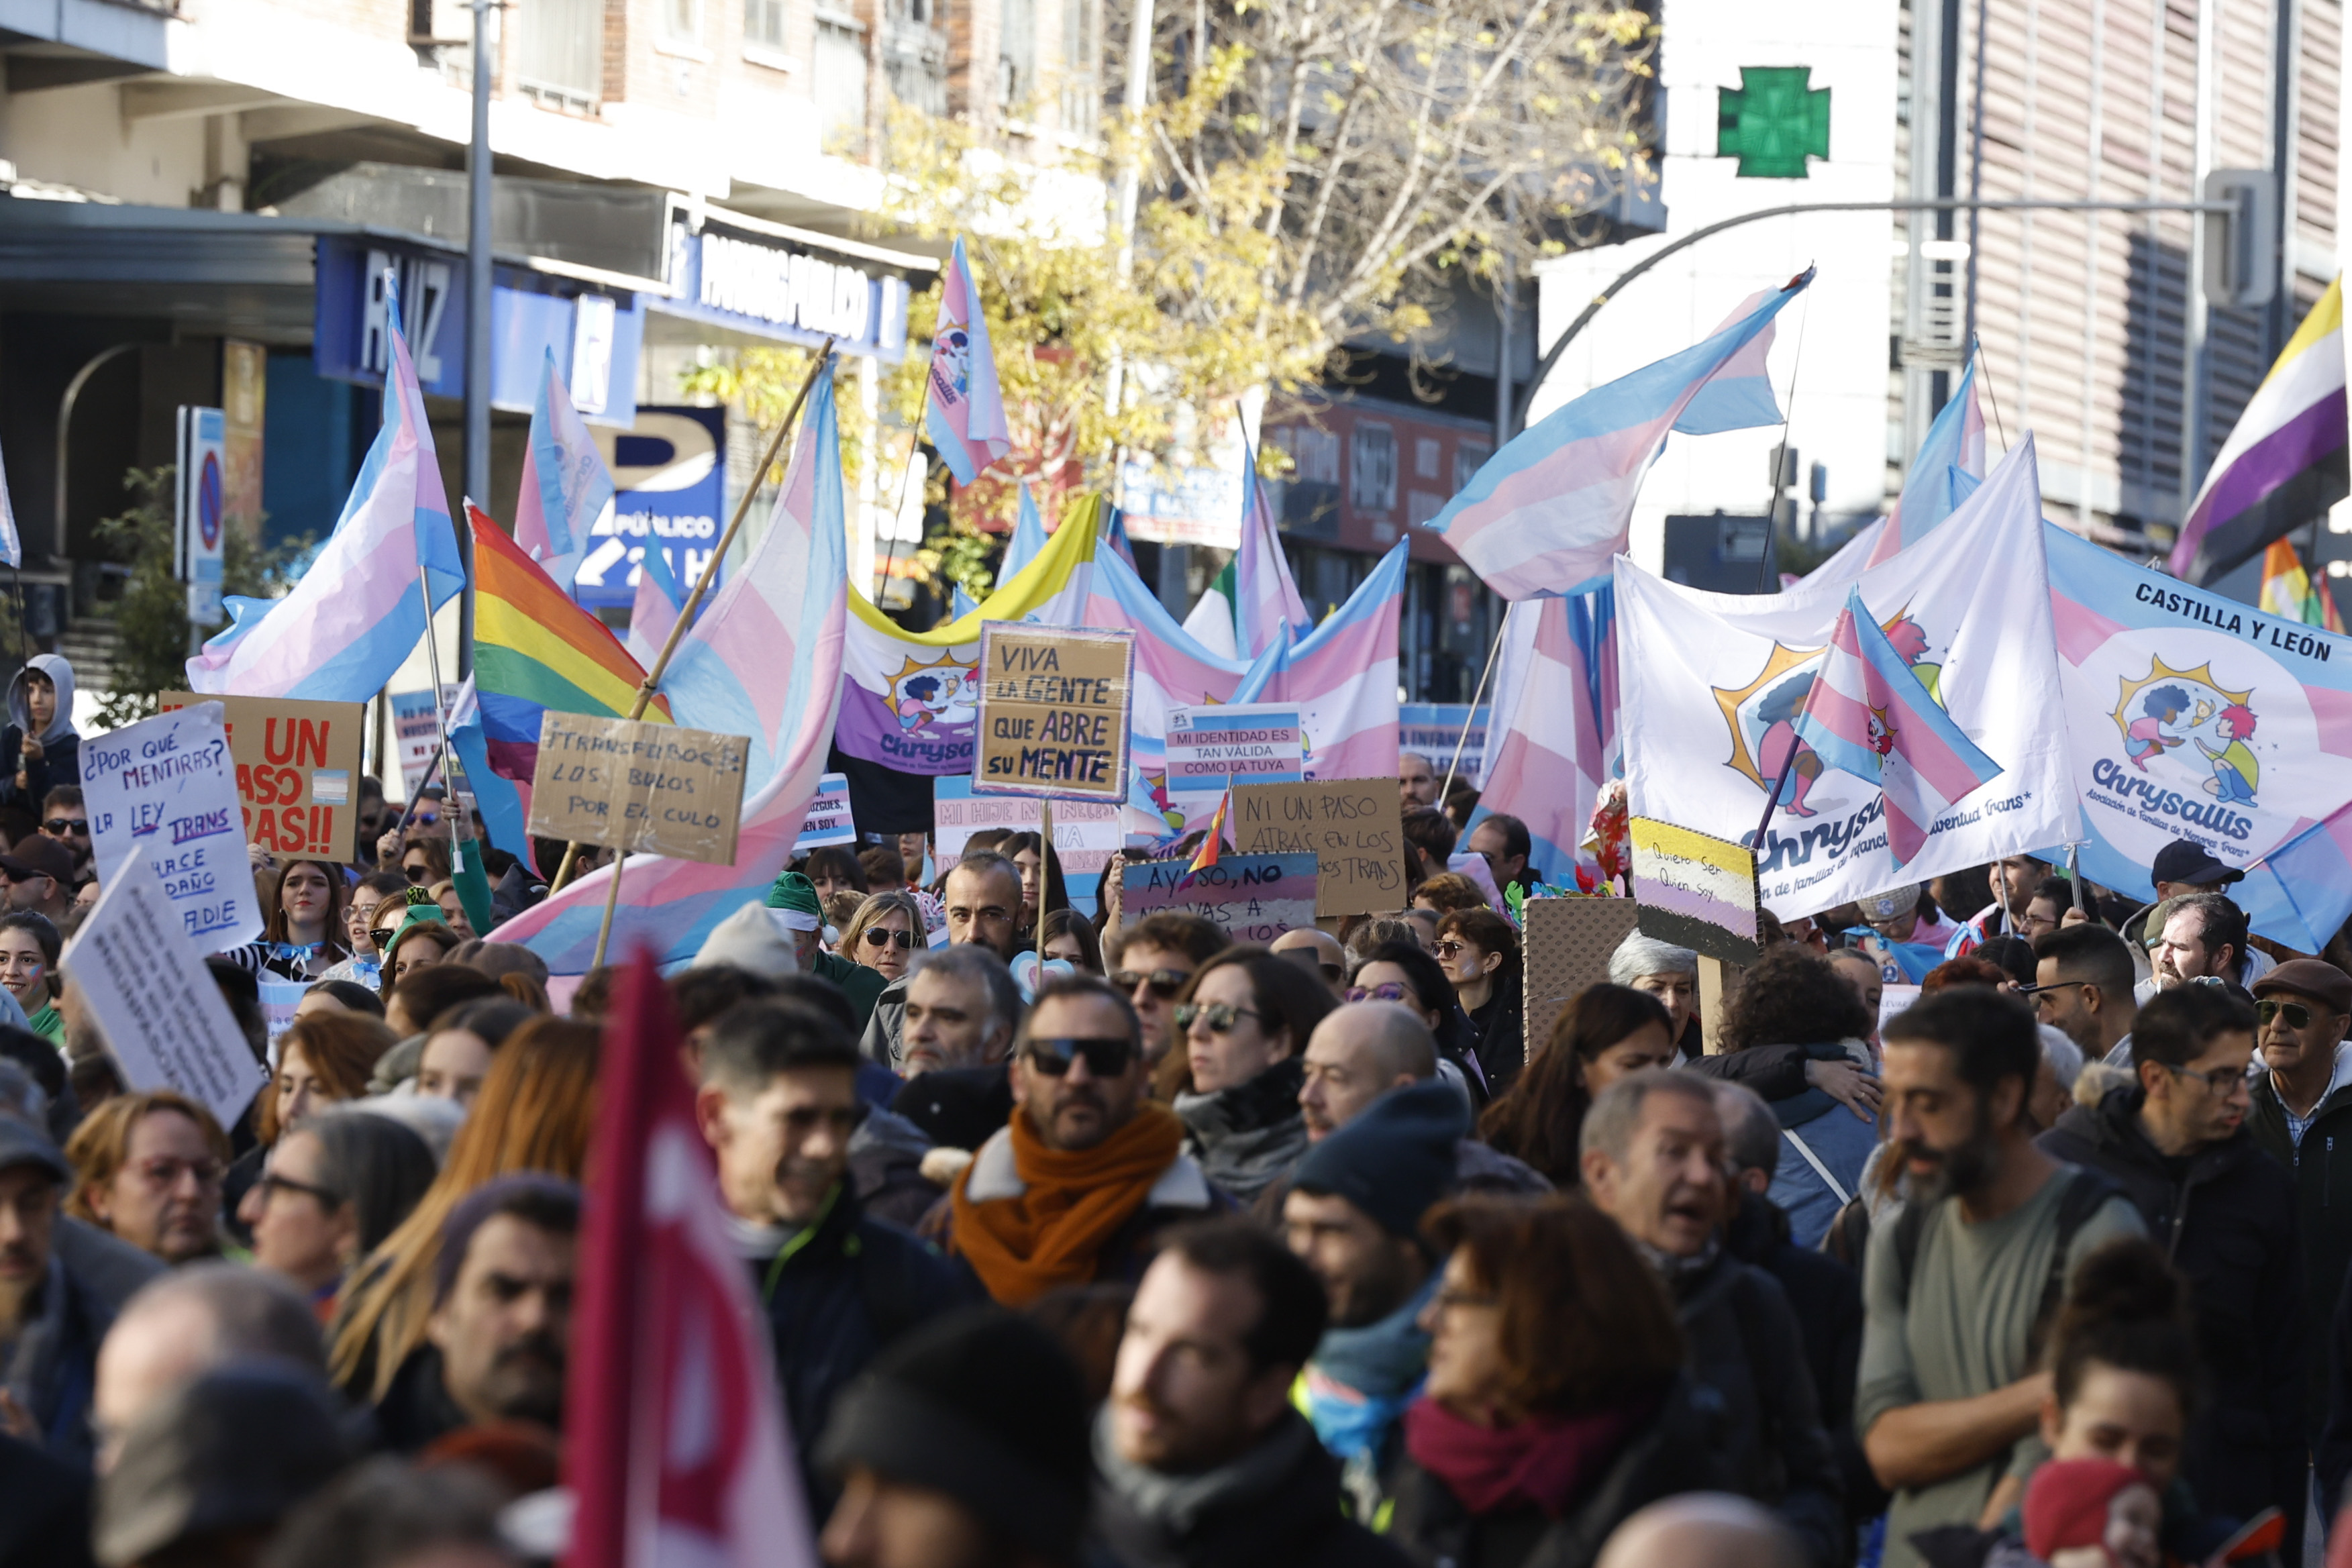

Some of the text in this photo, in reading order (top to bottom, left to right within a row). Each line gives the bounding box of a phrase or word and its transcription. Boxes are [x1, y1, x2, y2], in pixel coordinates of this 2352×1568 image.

[2135, 583, 2331, 662] CASTILLA Y LEÓN
[1001, 645, 1059, 672] VIVA
[996, 674, 1111, 704] LA GENTE
[264, 717, 329, 768] UN
[994, 710, 1109, 746] QUE ABRE
[1176, 730, 1289, 745] MI IDENTIDAD ES
[85, 745, 132, 782] ¿POR
[142, 722, 179, 758] QUÉ
[880, 733, 973, 762] Chrysa
[987, 756, 1014, 774] SU
[1019, 745, 1112, 783] MENTE
[1196, 745, 1273, 759] TAN VÁLIDA
[122, 739, 225, 790] MENTIRAS?
[552, 763, 695, 793] LOS BULOS
[1184, 760, 1284, 774] COMO LA TUYA
[236, 764, 303, 806] ASO
[2092, 758, 2253, 840] Chrysallis
[95, 802, 229, 844] LA LEY TRANS
[569, 796, 721, 829] POR EL CULO
[818, 818, 838, 831] SOY.
[940, 803, 962, 825] MI
[972, 802, 1013, 823] HIJE
[1021, 801, 1041, 821] N
[1284, 796, 1313, 821] UN
[1321, 795, 1377, 820] PASO
[2086, 788, 2126, 813] Asociación
[2127, 806, 2137, 817] de
[2139, 810, 2169, 831] Familias
[2171, 825, 2181, 835] de
[2183, 828, 2218, 848] Menores
[244, 806, 334, 854] AS!!
[1251, 824, 1393, 853] ATRÁS EN LOS
[1740, 790, 1888, 875] Chrysa
[1653, 842, 1722, 876] Quiero Ser
[1774, 882, 1791, 897] de
[1929, 807, 1982, 835] uventud
[165, 872, 215, 896] DAÑO
[1147, 865, 1282, 898] AYSO, NO
[1342, 857, 1400, 890] TRANS
[1660, 868, 1690, 892] Quien
[1247, 897, 1261, 917] A
